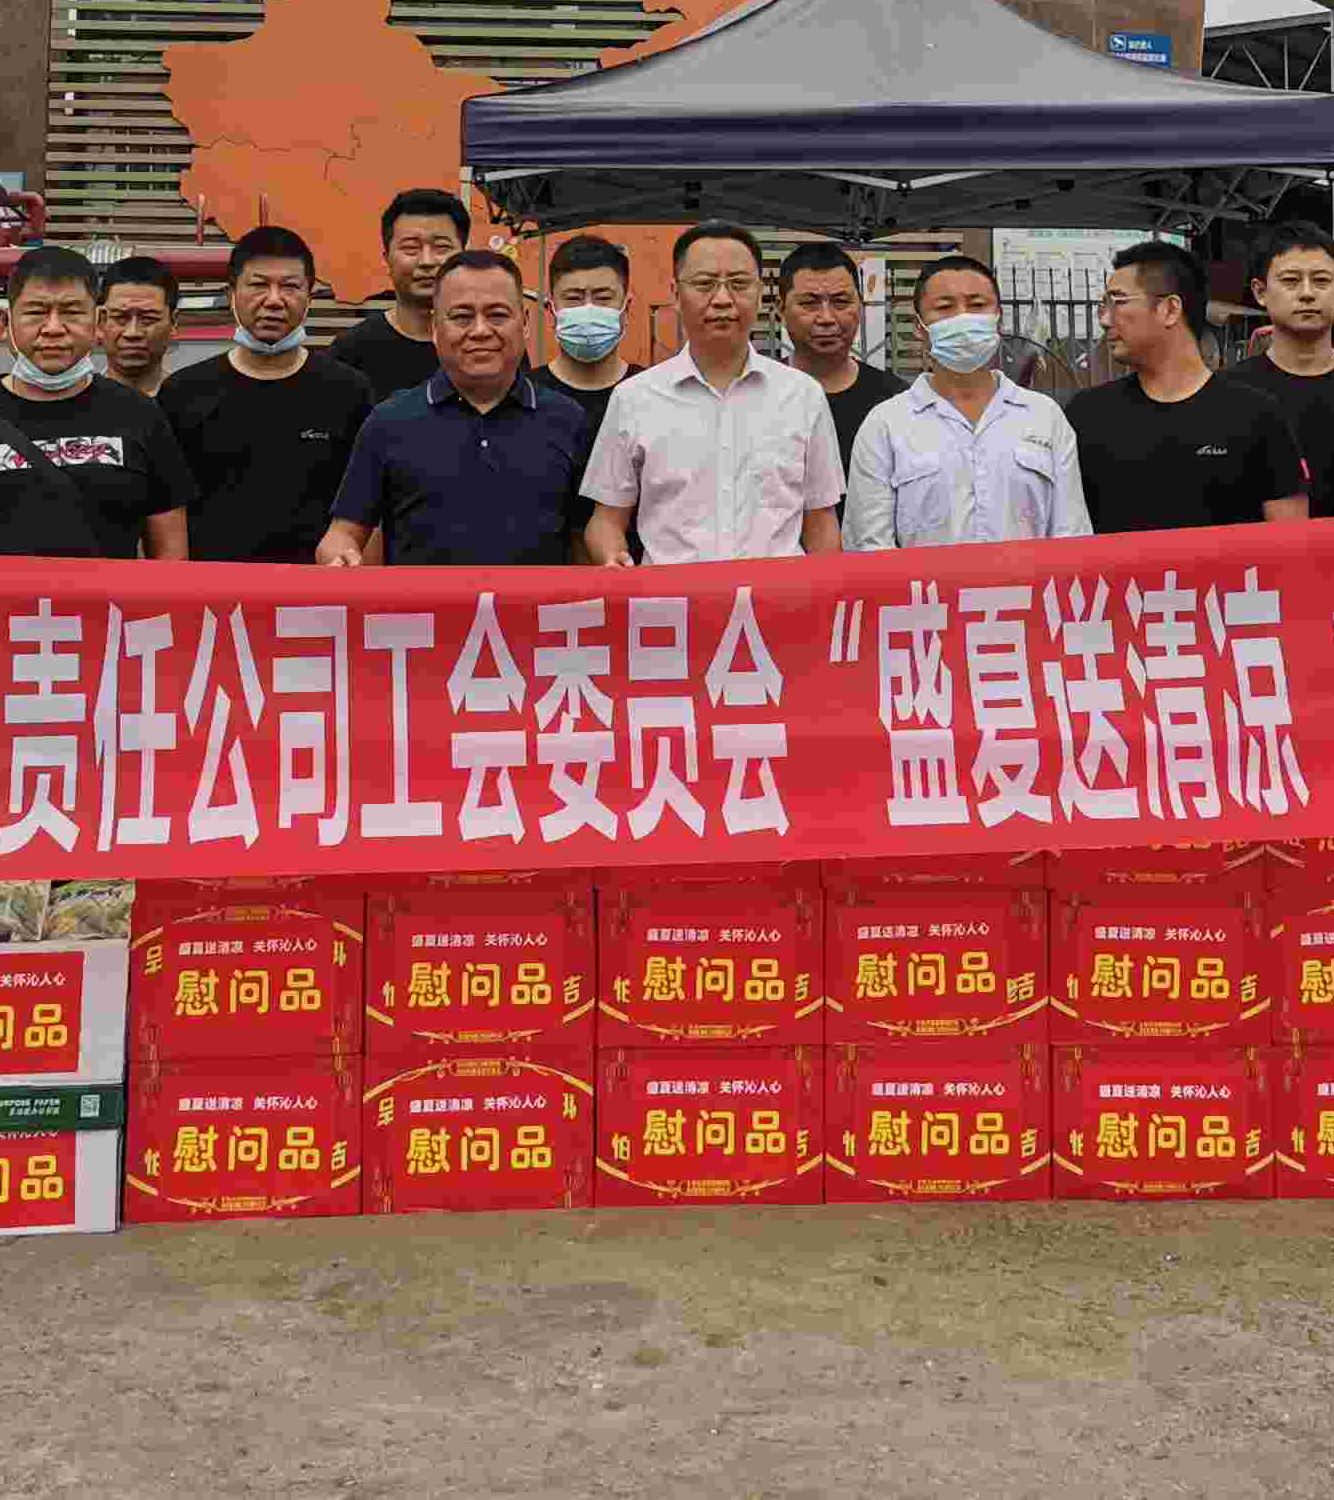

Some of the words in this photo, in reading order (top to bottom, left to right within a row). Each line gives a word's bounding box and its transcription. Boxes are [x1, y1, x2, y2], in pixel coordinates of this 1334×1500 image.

[719, 928, 782, 942] 关怀沁人心
[929, 922, 990, 937] 关怀沁人心
[1164, 927, 1226, 942] 关怀沁人心
[253, 939, 318, 953] 关怀沁人心
[484, 933, 548, 947] 关怀沁人心
[0, 972, 66, 988] 关怀沁人心
[642, 956, 785, 1002] 慰问品
[855, 951, 996, 998] 慰问品
[1090, 953, 1230, 999] 慰问品
[174, 968, 322, 1016] 慰问品
[408, 961, 552, 1007] 慰问品
[719, 1080, 782, 1094] 关怀沁人心
[943, 1082, 1006, 1096] 关怀沁人心
[1170, 1084, 1232, 1099] 关怀沁人心
[252, 1095, 318, 1110] 关怀沁人心
[482, 1095, 547, 1110] 关怀沁人心
[642, 1108, 786, 1156] 慰问品
[868, 1110, 1010, 1156] 慰问品
[1096, 1112, 1236, 1159] 慰问品
[173, 1125, 321, 1173] 慰问品
[406, 1124, 552, 1174] 慰问品
